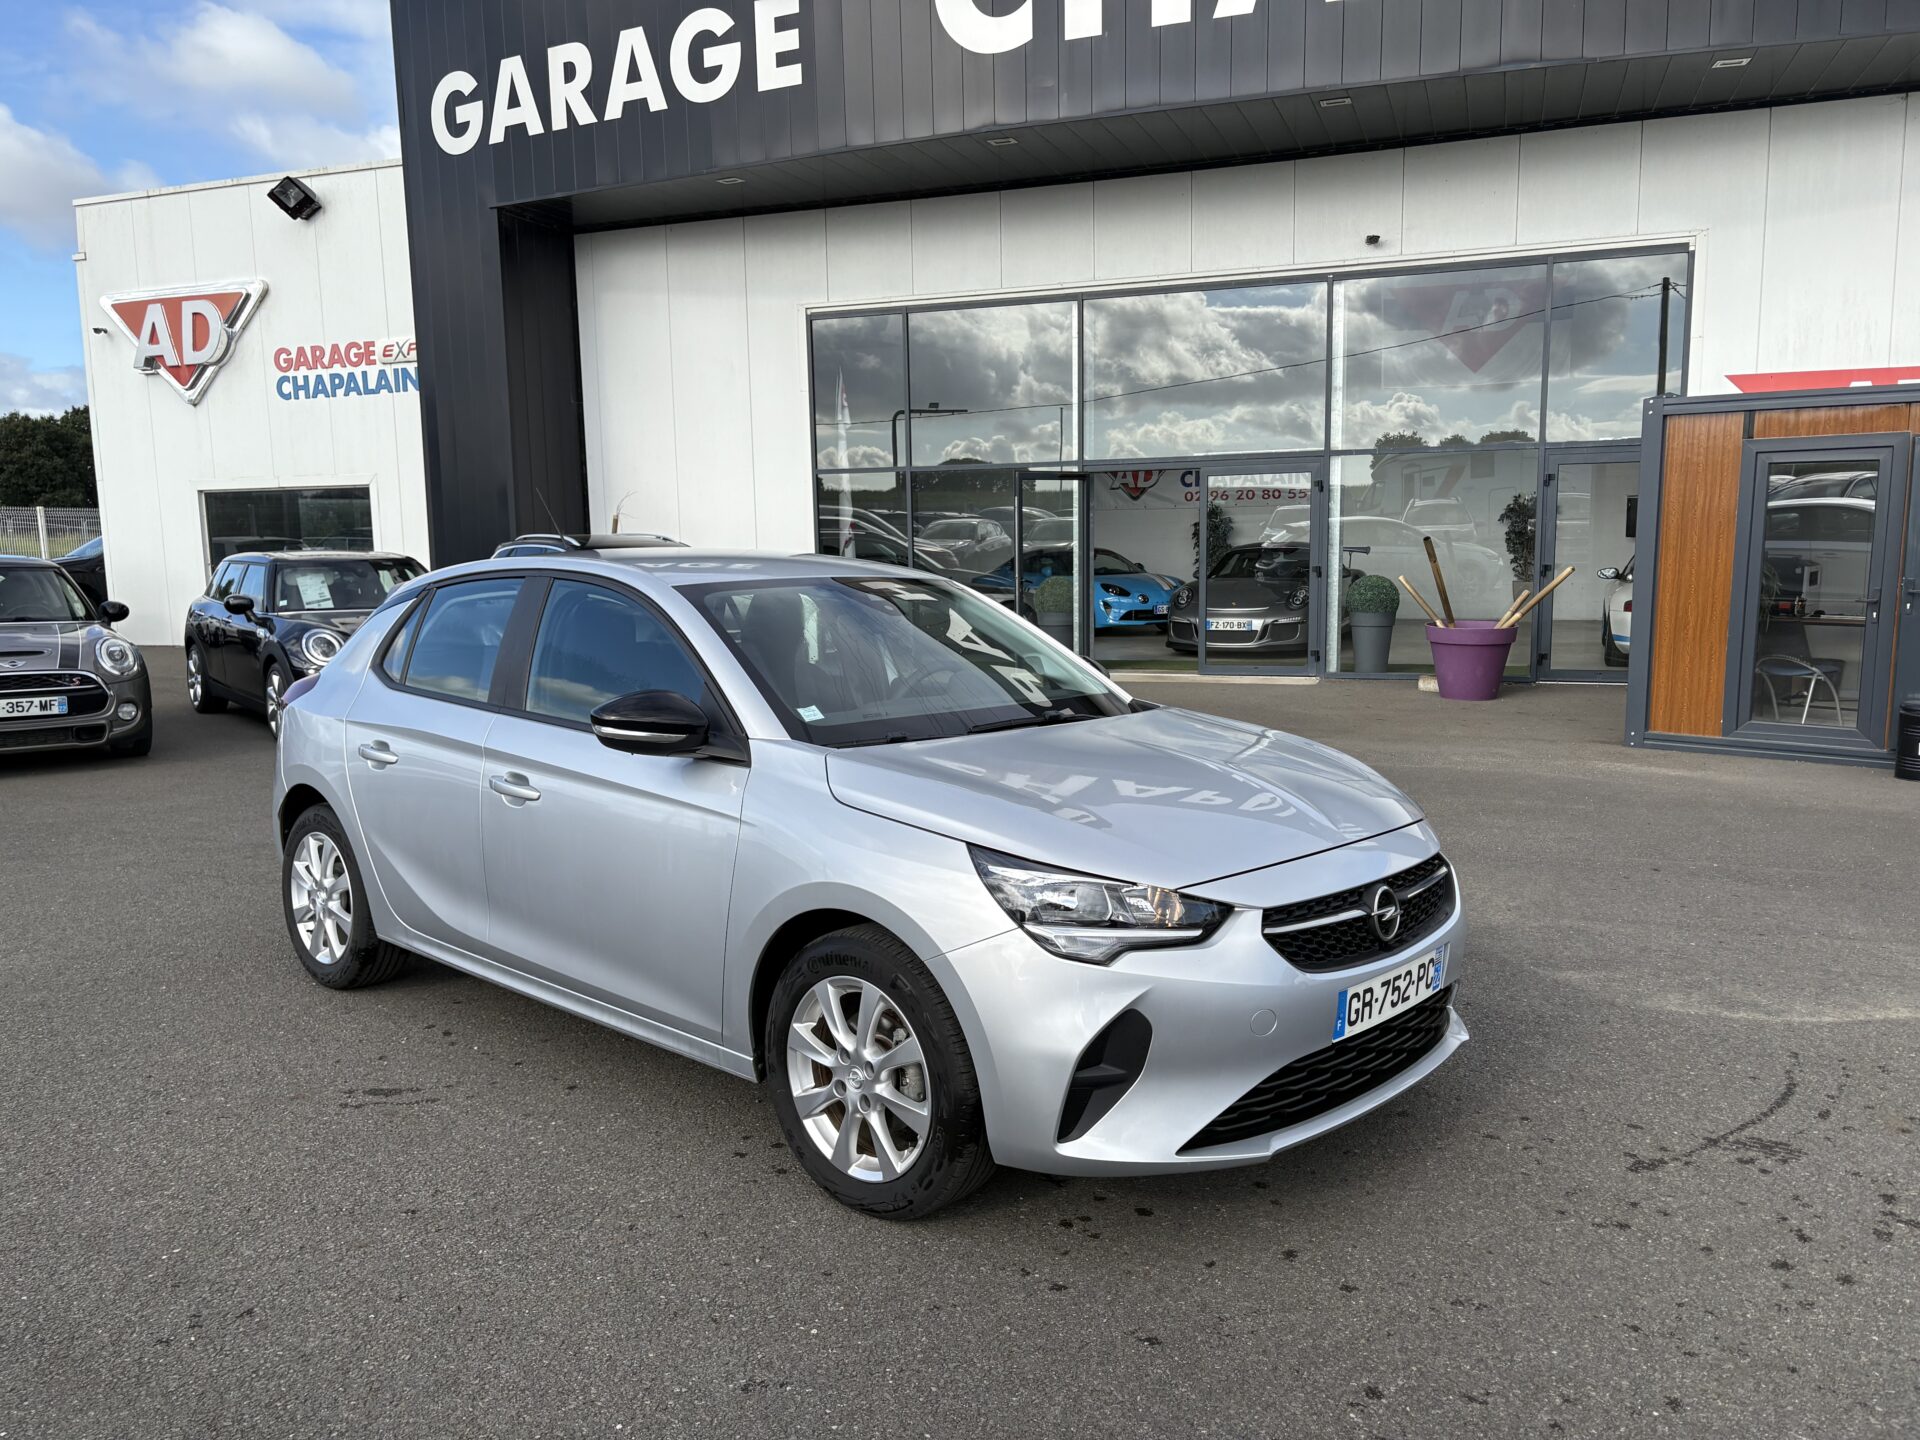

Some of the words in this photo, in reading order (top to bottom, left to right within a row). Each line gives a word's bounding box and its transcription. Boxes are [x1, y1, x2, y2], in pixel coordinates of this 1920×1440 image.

[431, 0, 803, 155] GARAGE
[133, 299, 223, 369] AD
[273, 340, 377, 373] GARAGE
[276, 366, 420, 400] CHAPALAIN
[1210, 490, 1229, 501] 96
[1236, 489, 1256, 501] 20
[1261, 488, 1282, 500] 80
[1287, 488, 1308, 499] 55
[1347, 957, 1434, 1027] GR-752-PC
